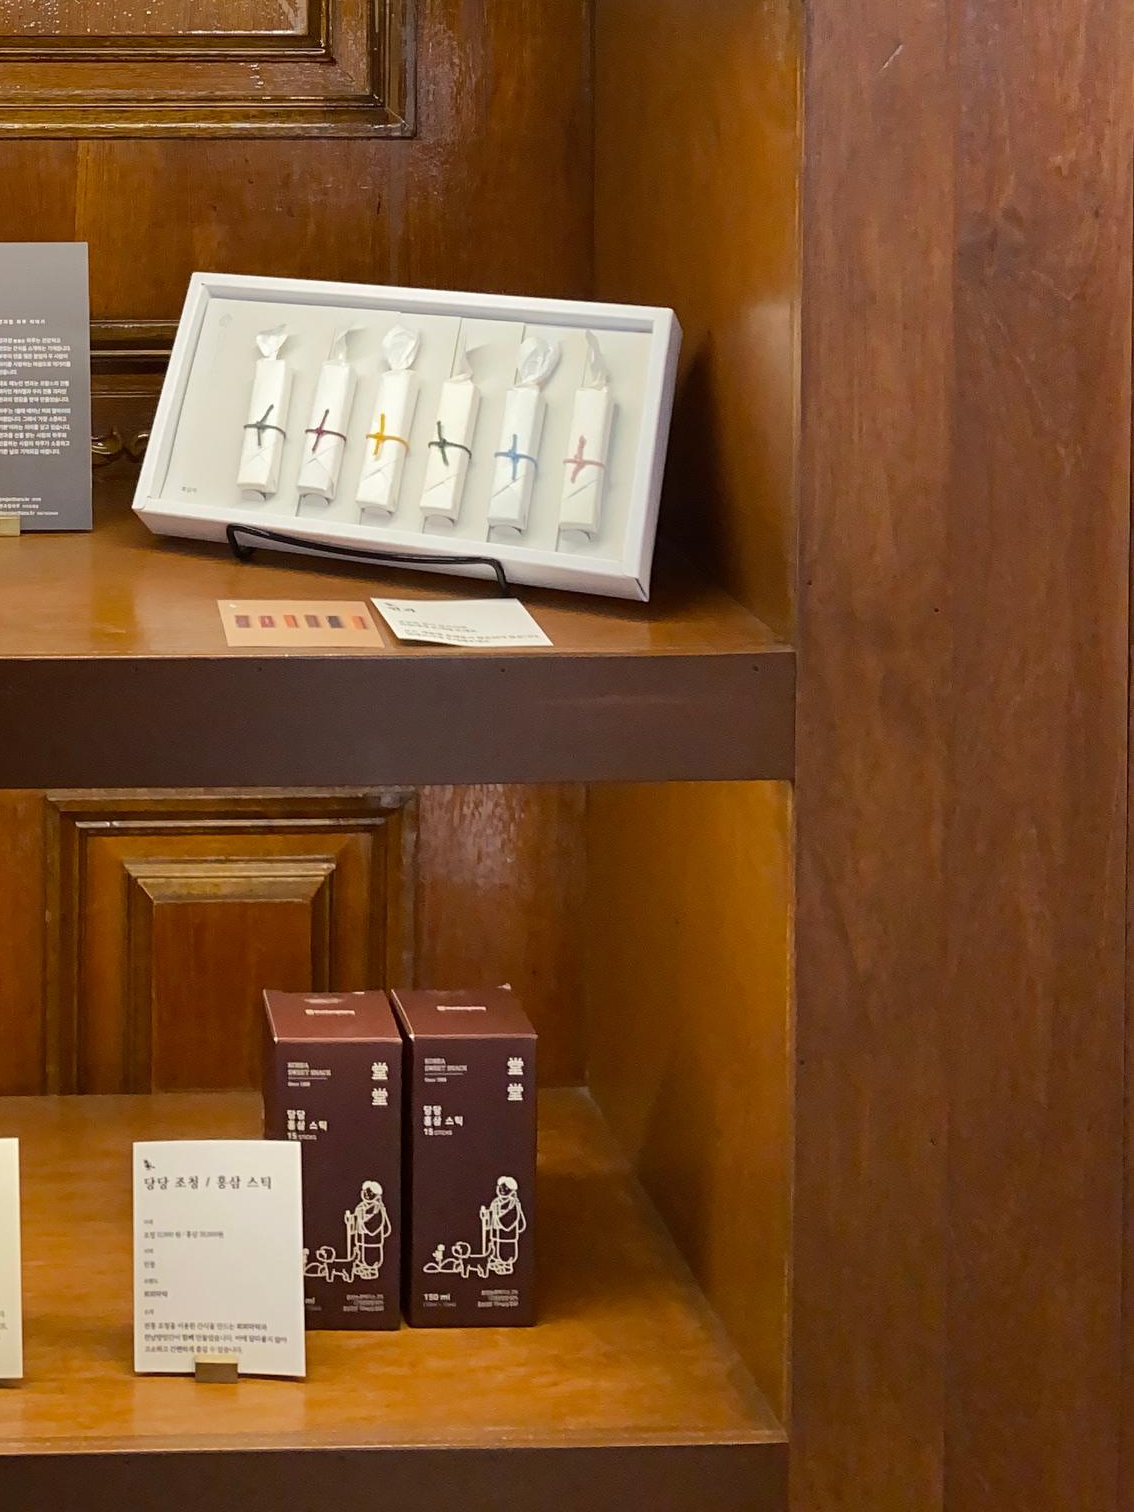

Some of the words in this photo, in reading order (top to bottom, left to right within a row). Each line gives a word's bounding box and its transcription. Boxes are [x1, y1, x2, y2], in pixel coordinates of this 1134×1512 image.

[309, 1120, 328, 1131] 스틱
[445, 1115, 463, 1126] 스틱
[423, 1128, 433, 1136] 15
[144, 1177, 168, 1190] 당당
[175, 1176, 199, 1190] 조청
[217, 1176, 242, 1189] 홍삼
[247, 1176, 272, 1190] 스틱
